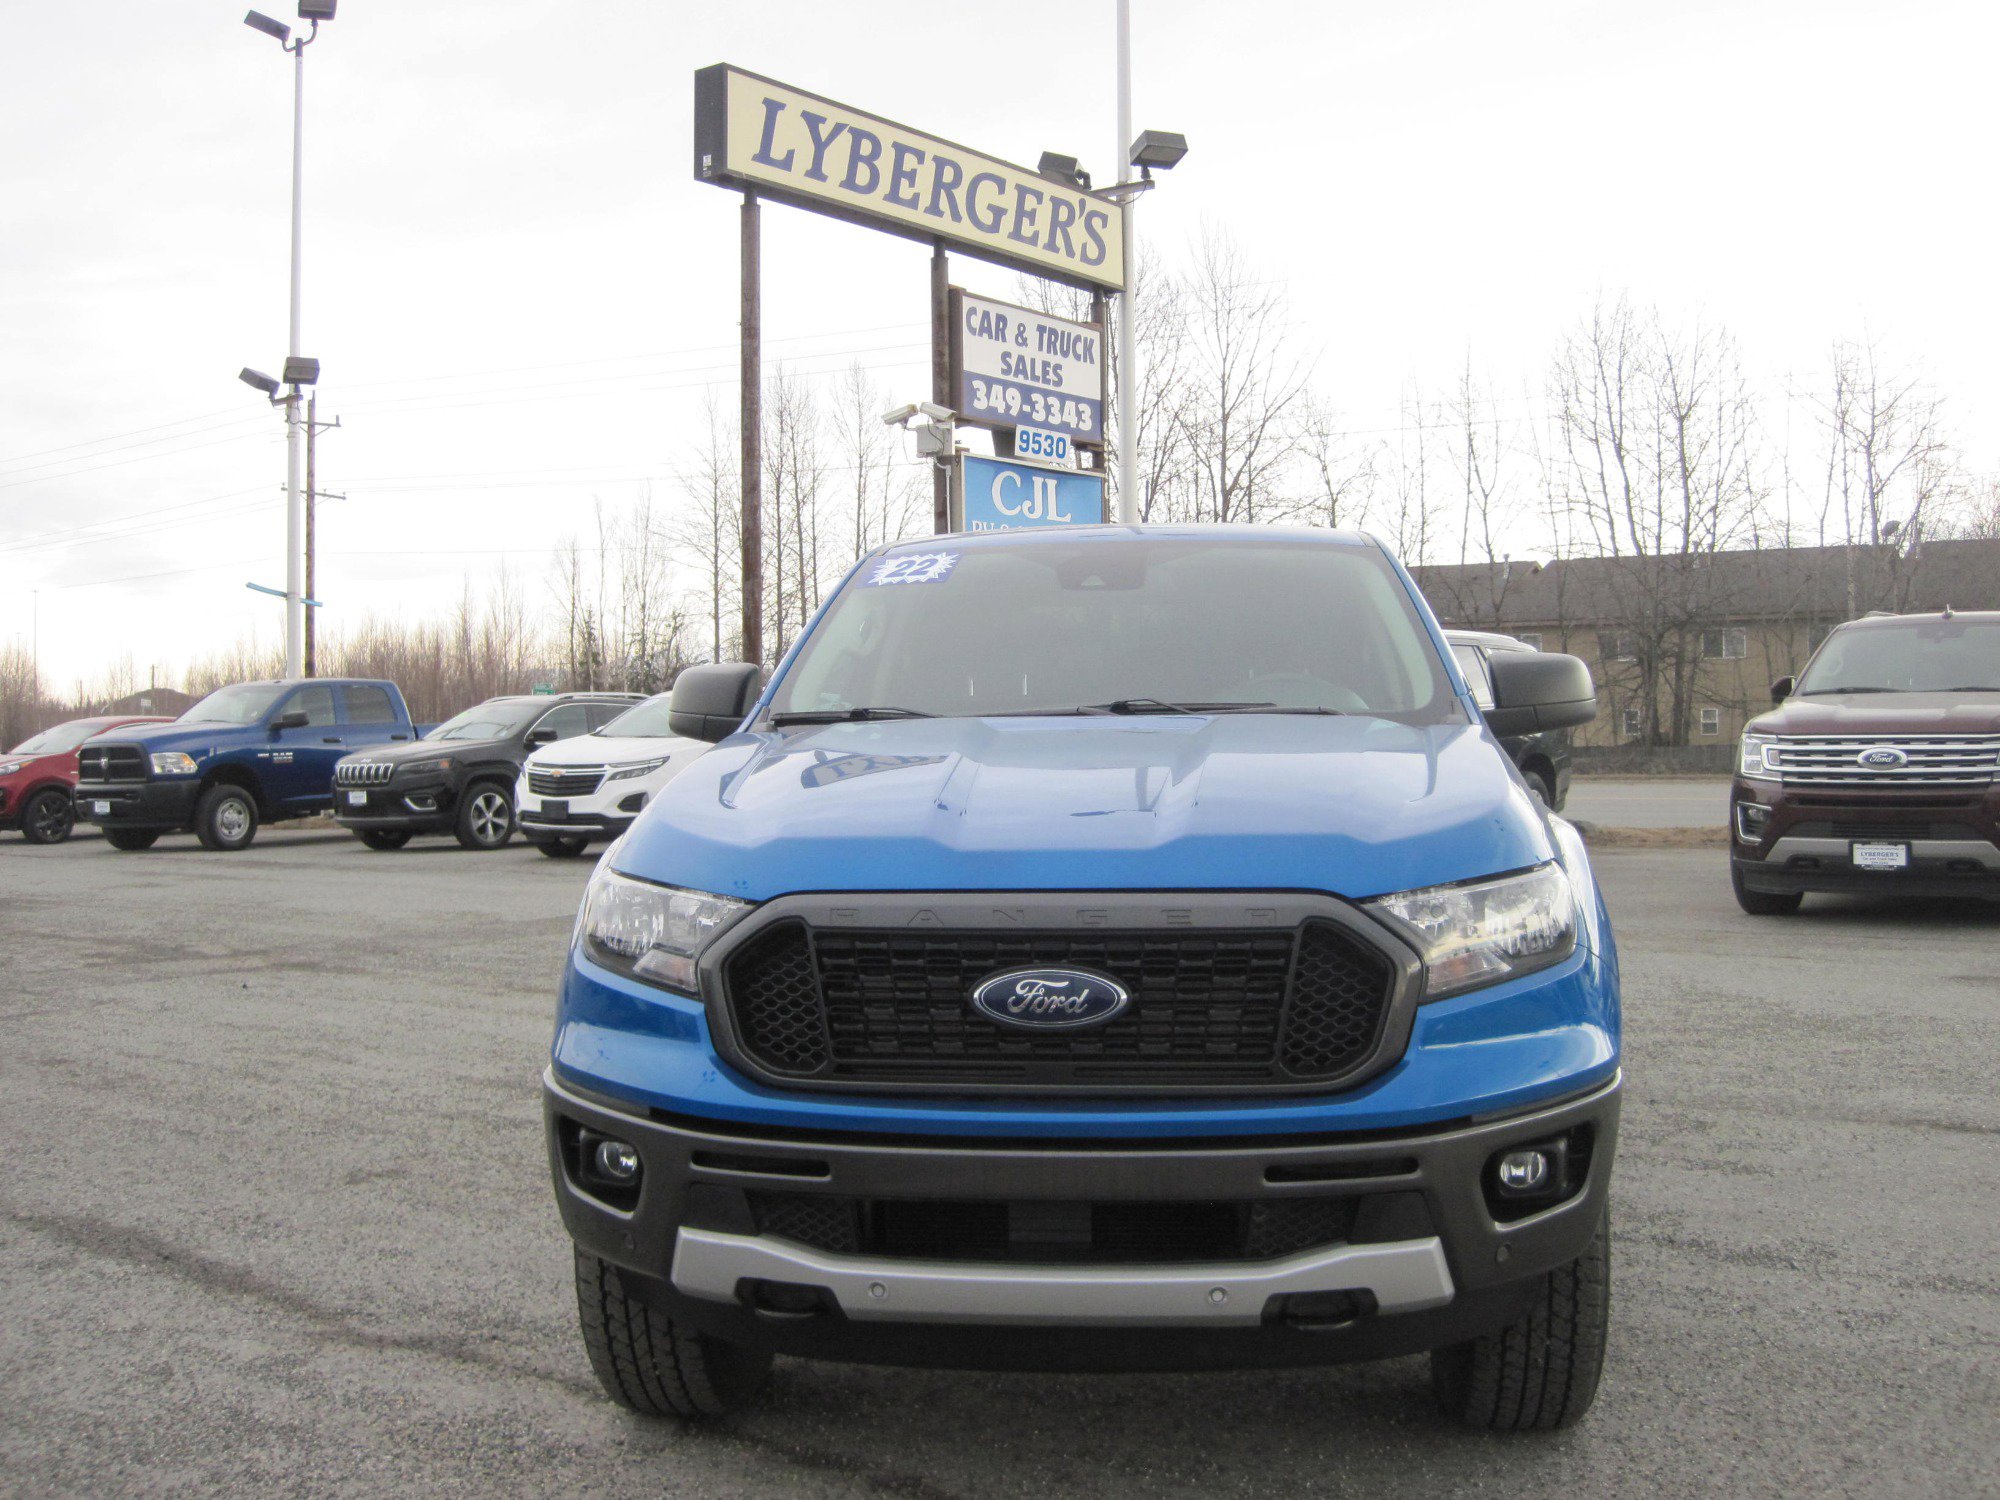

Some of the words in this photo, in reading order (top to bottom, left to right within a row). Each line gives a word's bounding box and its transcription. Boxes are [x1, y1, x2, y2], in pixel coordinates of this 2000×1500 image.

[751, 97, 1109, 267] LYBERGER'S
[965, 306, 1008, 344] CAR
[1014, 322, 1028, 348] &
[1036, 324, 1095, 365] TRUCK
[1000, 351, 1064, 388] SALES
[972, 379, 1092, 431] 349-3343
[1018, 429, 1067, 459] 9530
[991, 470, 1072, 523] CJL
[884, 558, 938, 578] 22
[1870, 753, 1893, 763] Ford
[829, 907, 1279, 928] RANGER
[1007, 979, 1090, 1014] Ford
